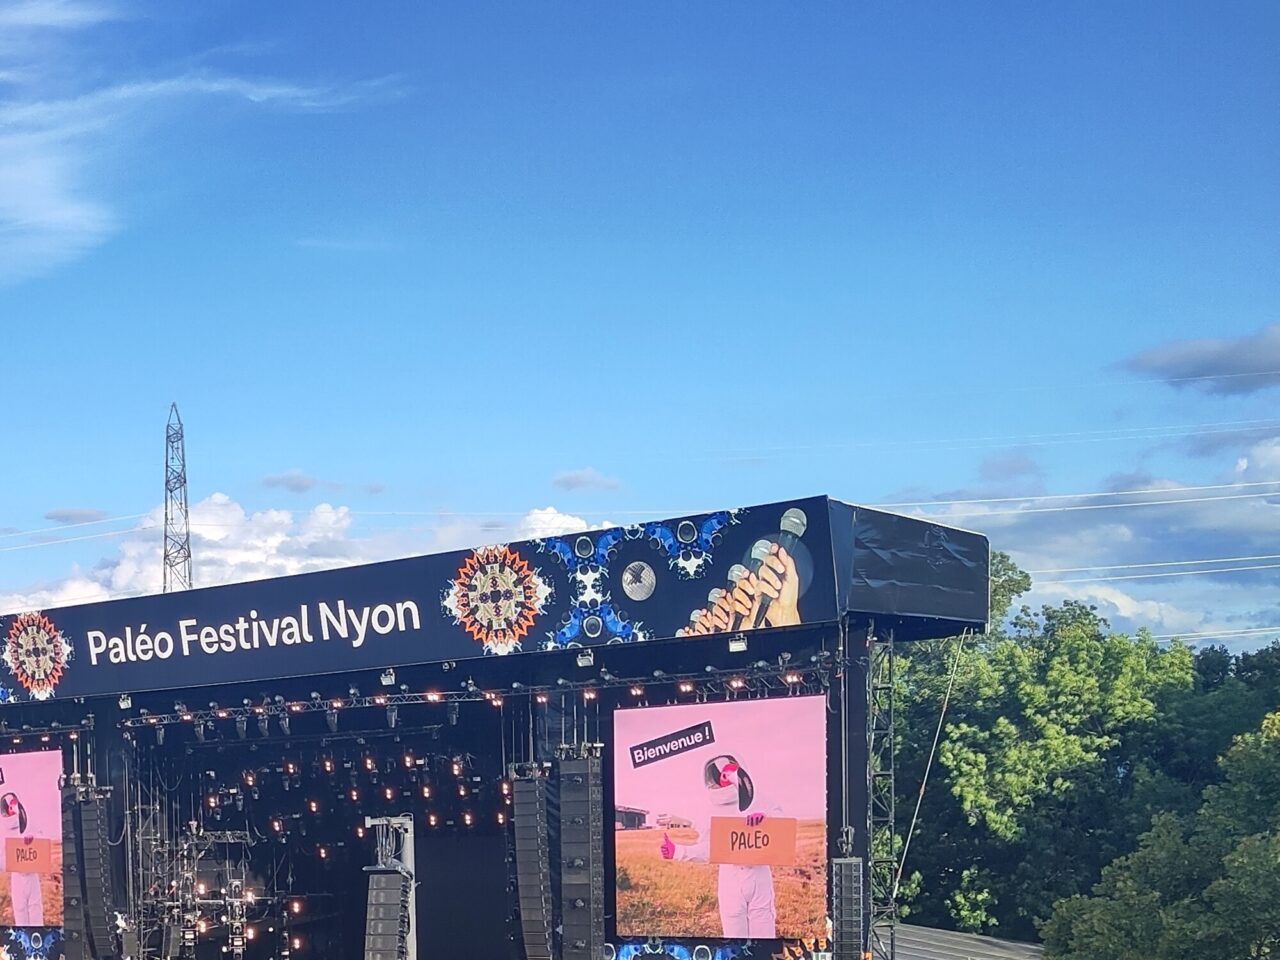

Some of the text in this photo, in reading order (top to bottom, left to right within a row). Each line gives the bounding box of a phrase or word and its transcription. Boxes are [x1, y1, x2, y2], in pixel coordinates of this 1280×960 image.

[87, 599, 421, 665] Paléo Festival Nyon
[633, 731, 703, 763] Bienvenue
